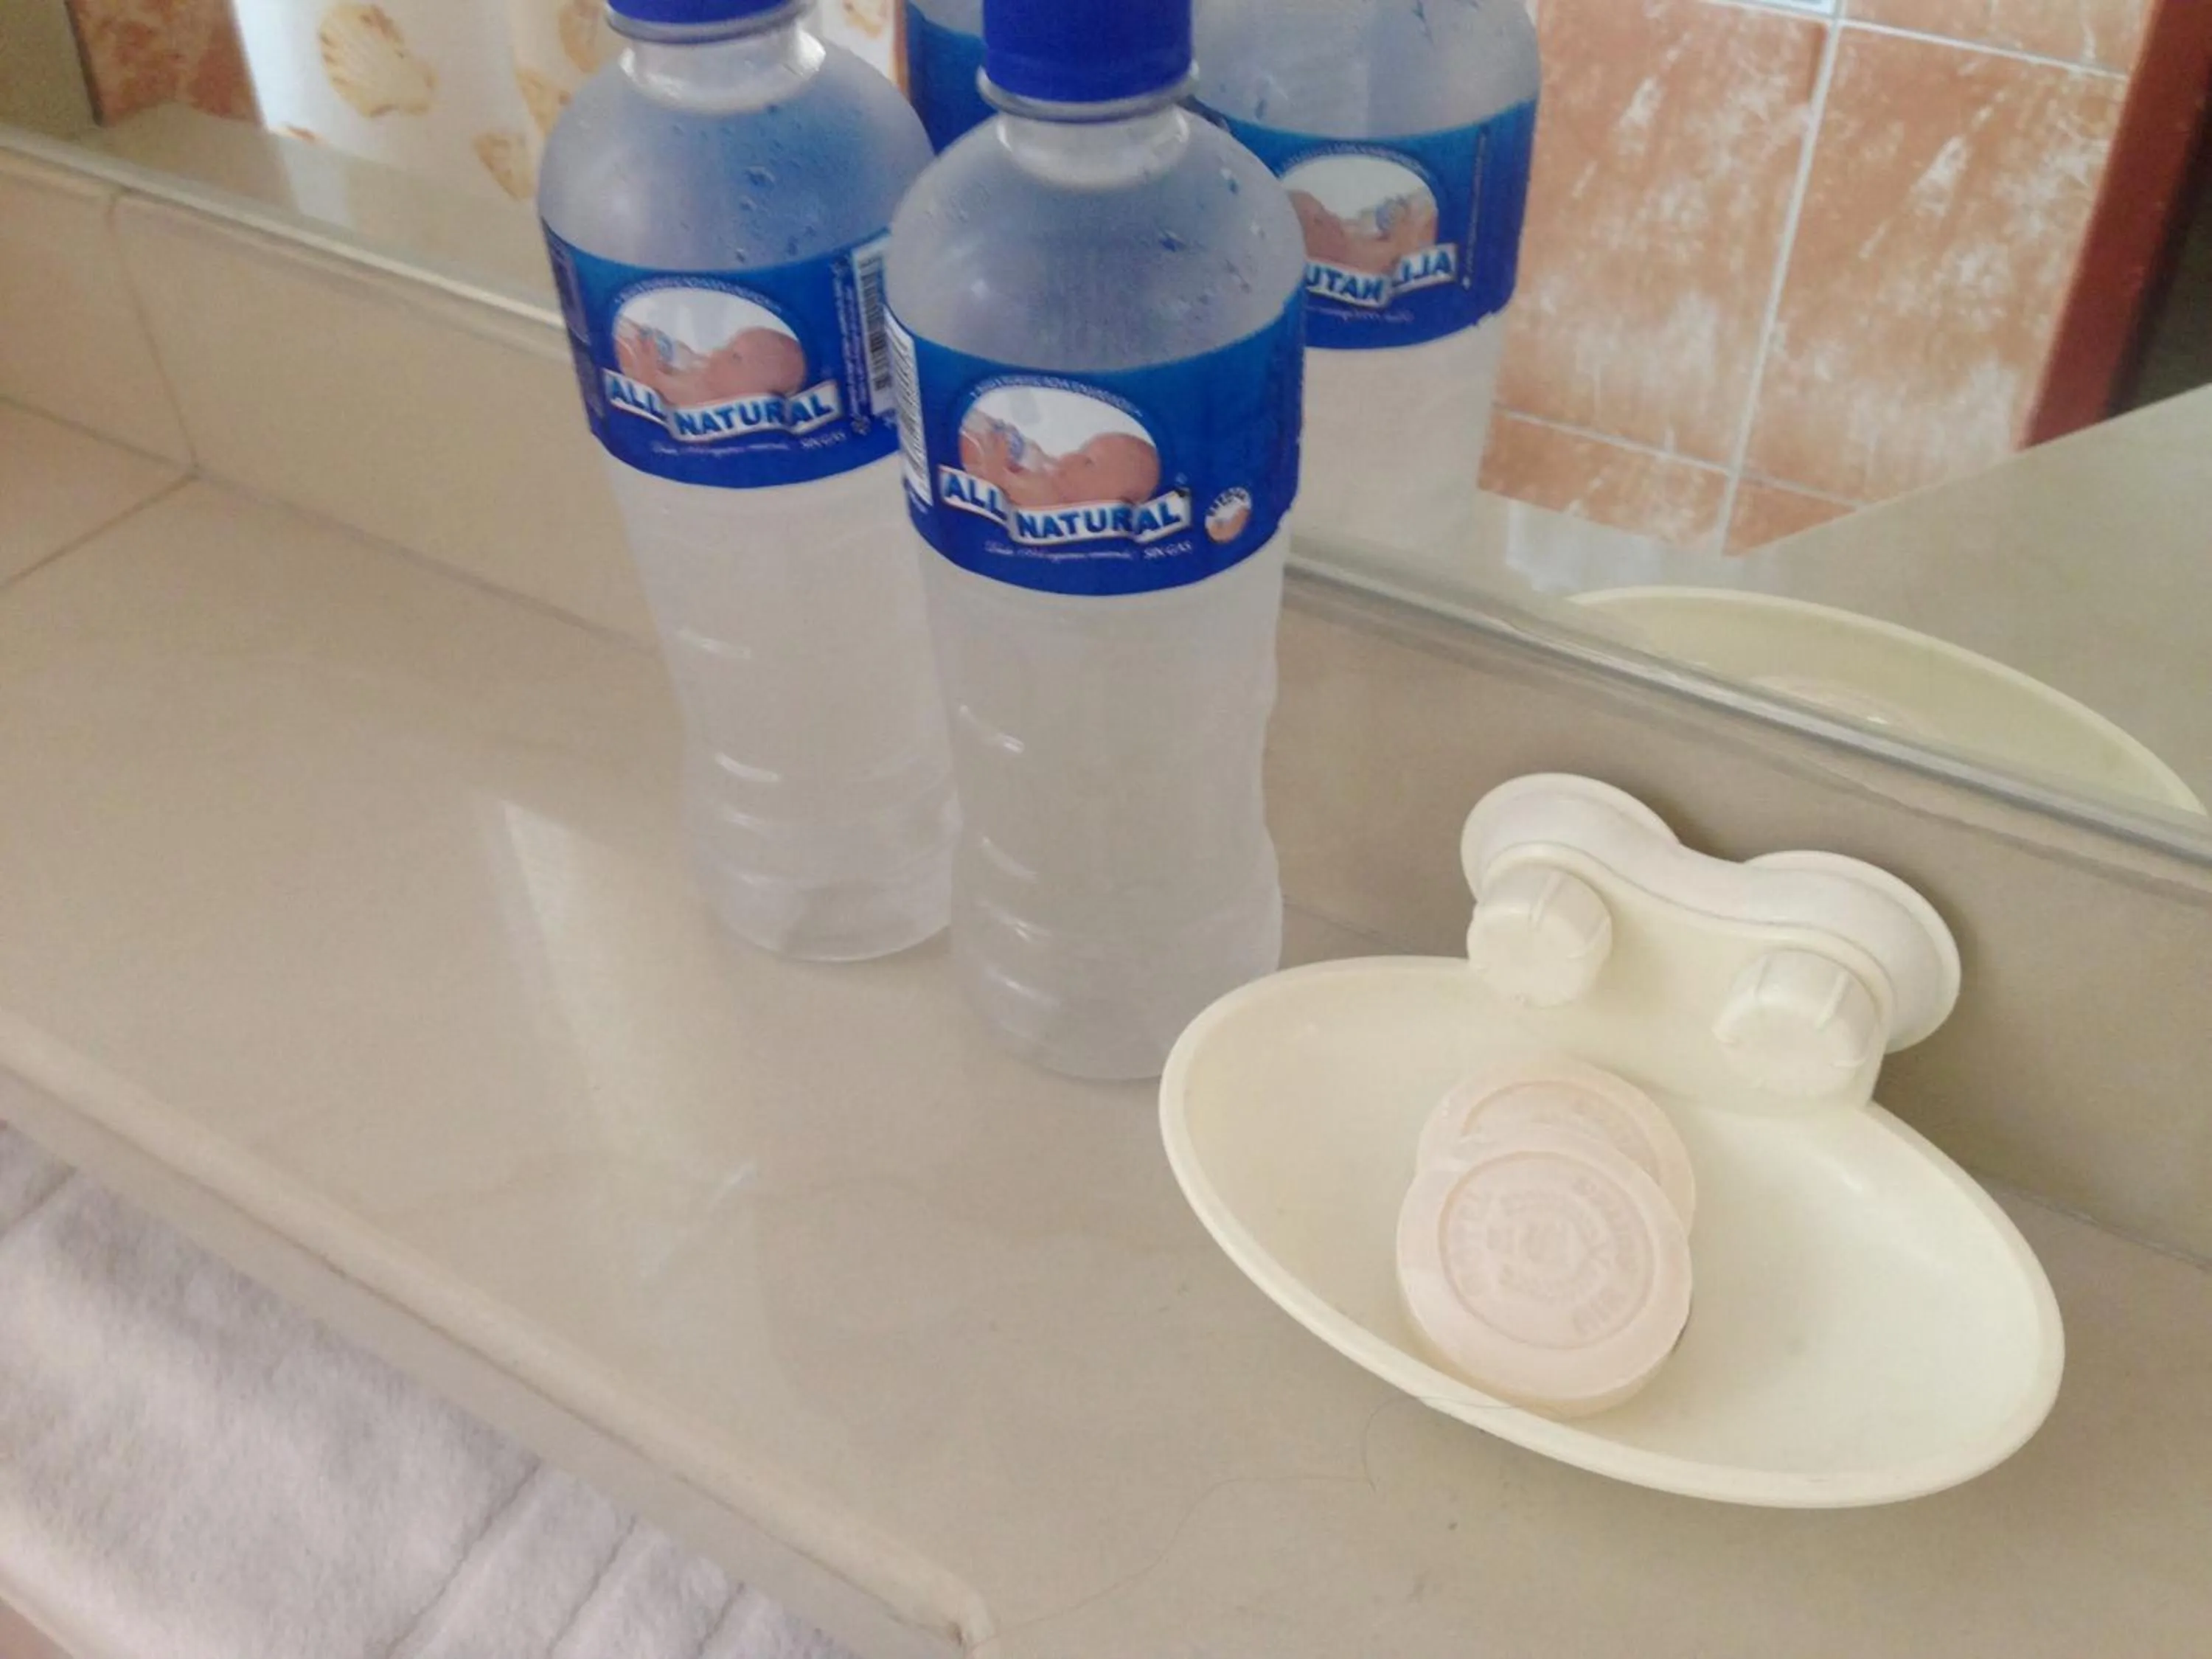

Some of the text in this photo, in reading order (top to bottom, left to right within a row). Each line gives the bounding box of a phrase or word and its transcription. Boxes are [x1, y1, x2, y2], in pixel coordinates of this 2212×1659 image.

[610, 380, 833, 437] ALL NATURAL
[945, 473, 1007, 521] ALL
[1015, 501, 1181, 538] NATURAL
